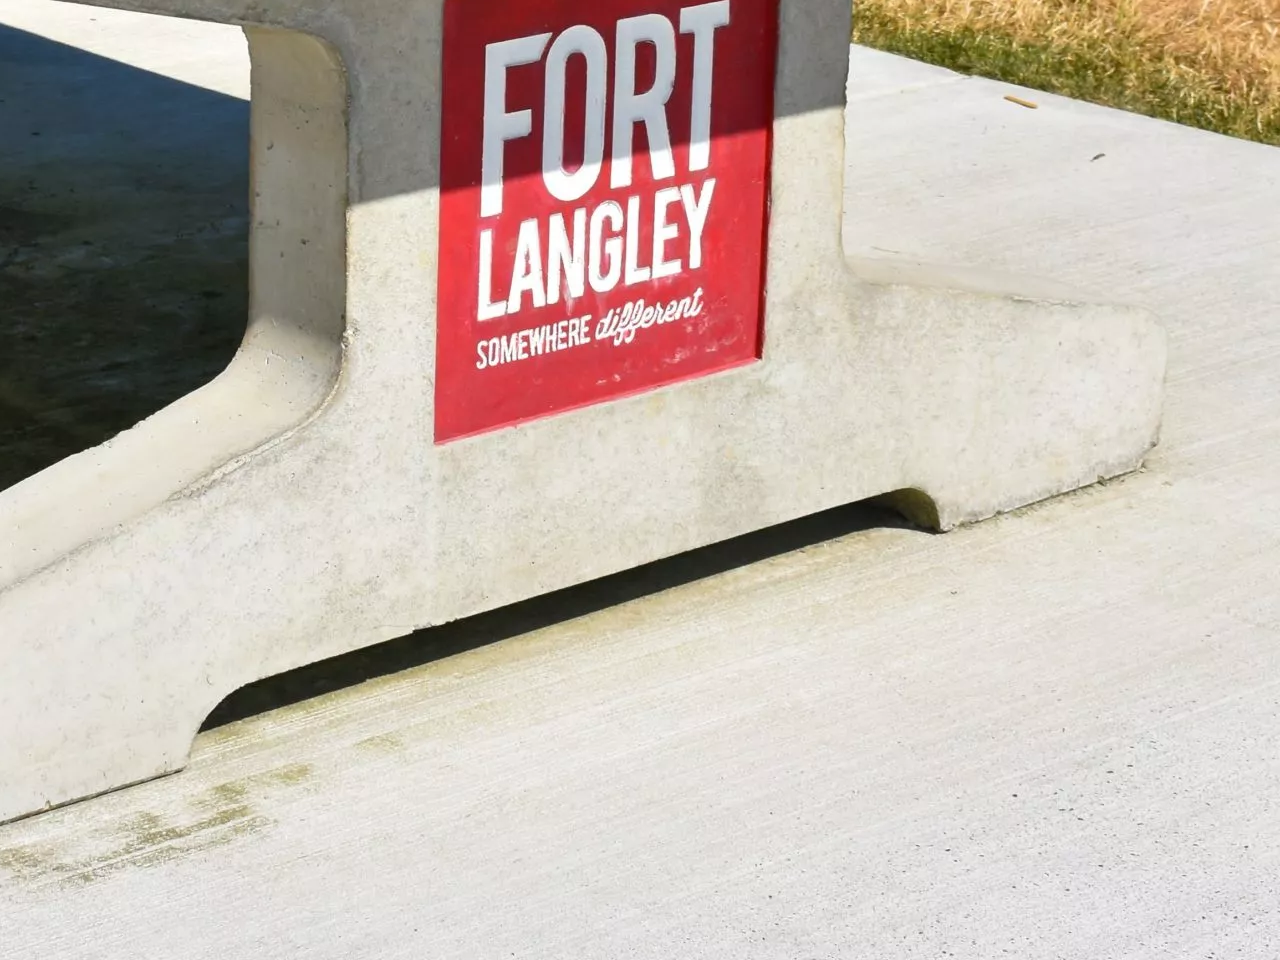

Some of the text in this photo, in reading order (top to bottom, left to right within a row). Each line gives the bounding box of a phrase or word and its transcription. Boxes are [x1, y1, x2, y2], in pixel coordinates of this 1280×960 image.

[479, 0, 730, 220] FORT
[476, 177, 717, 323] LANGLEY
[475, 287, 705, 370] SOMEWHERE different
